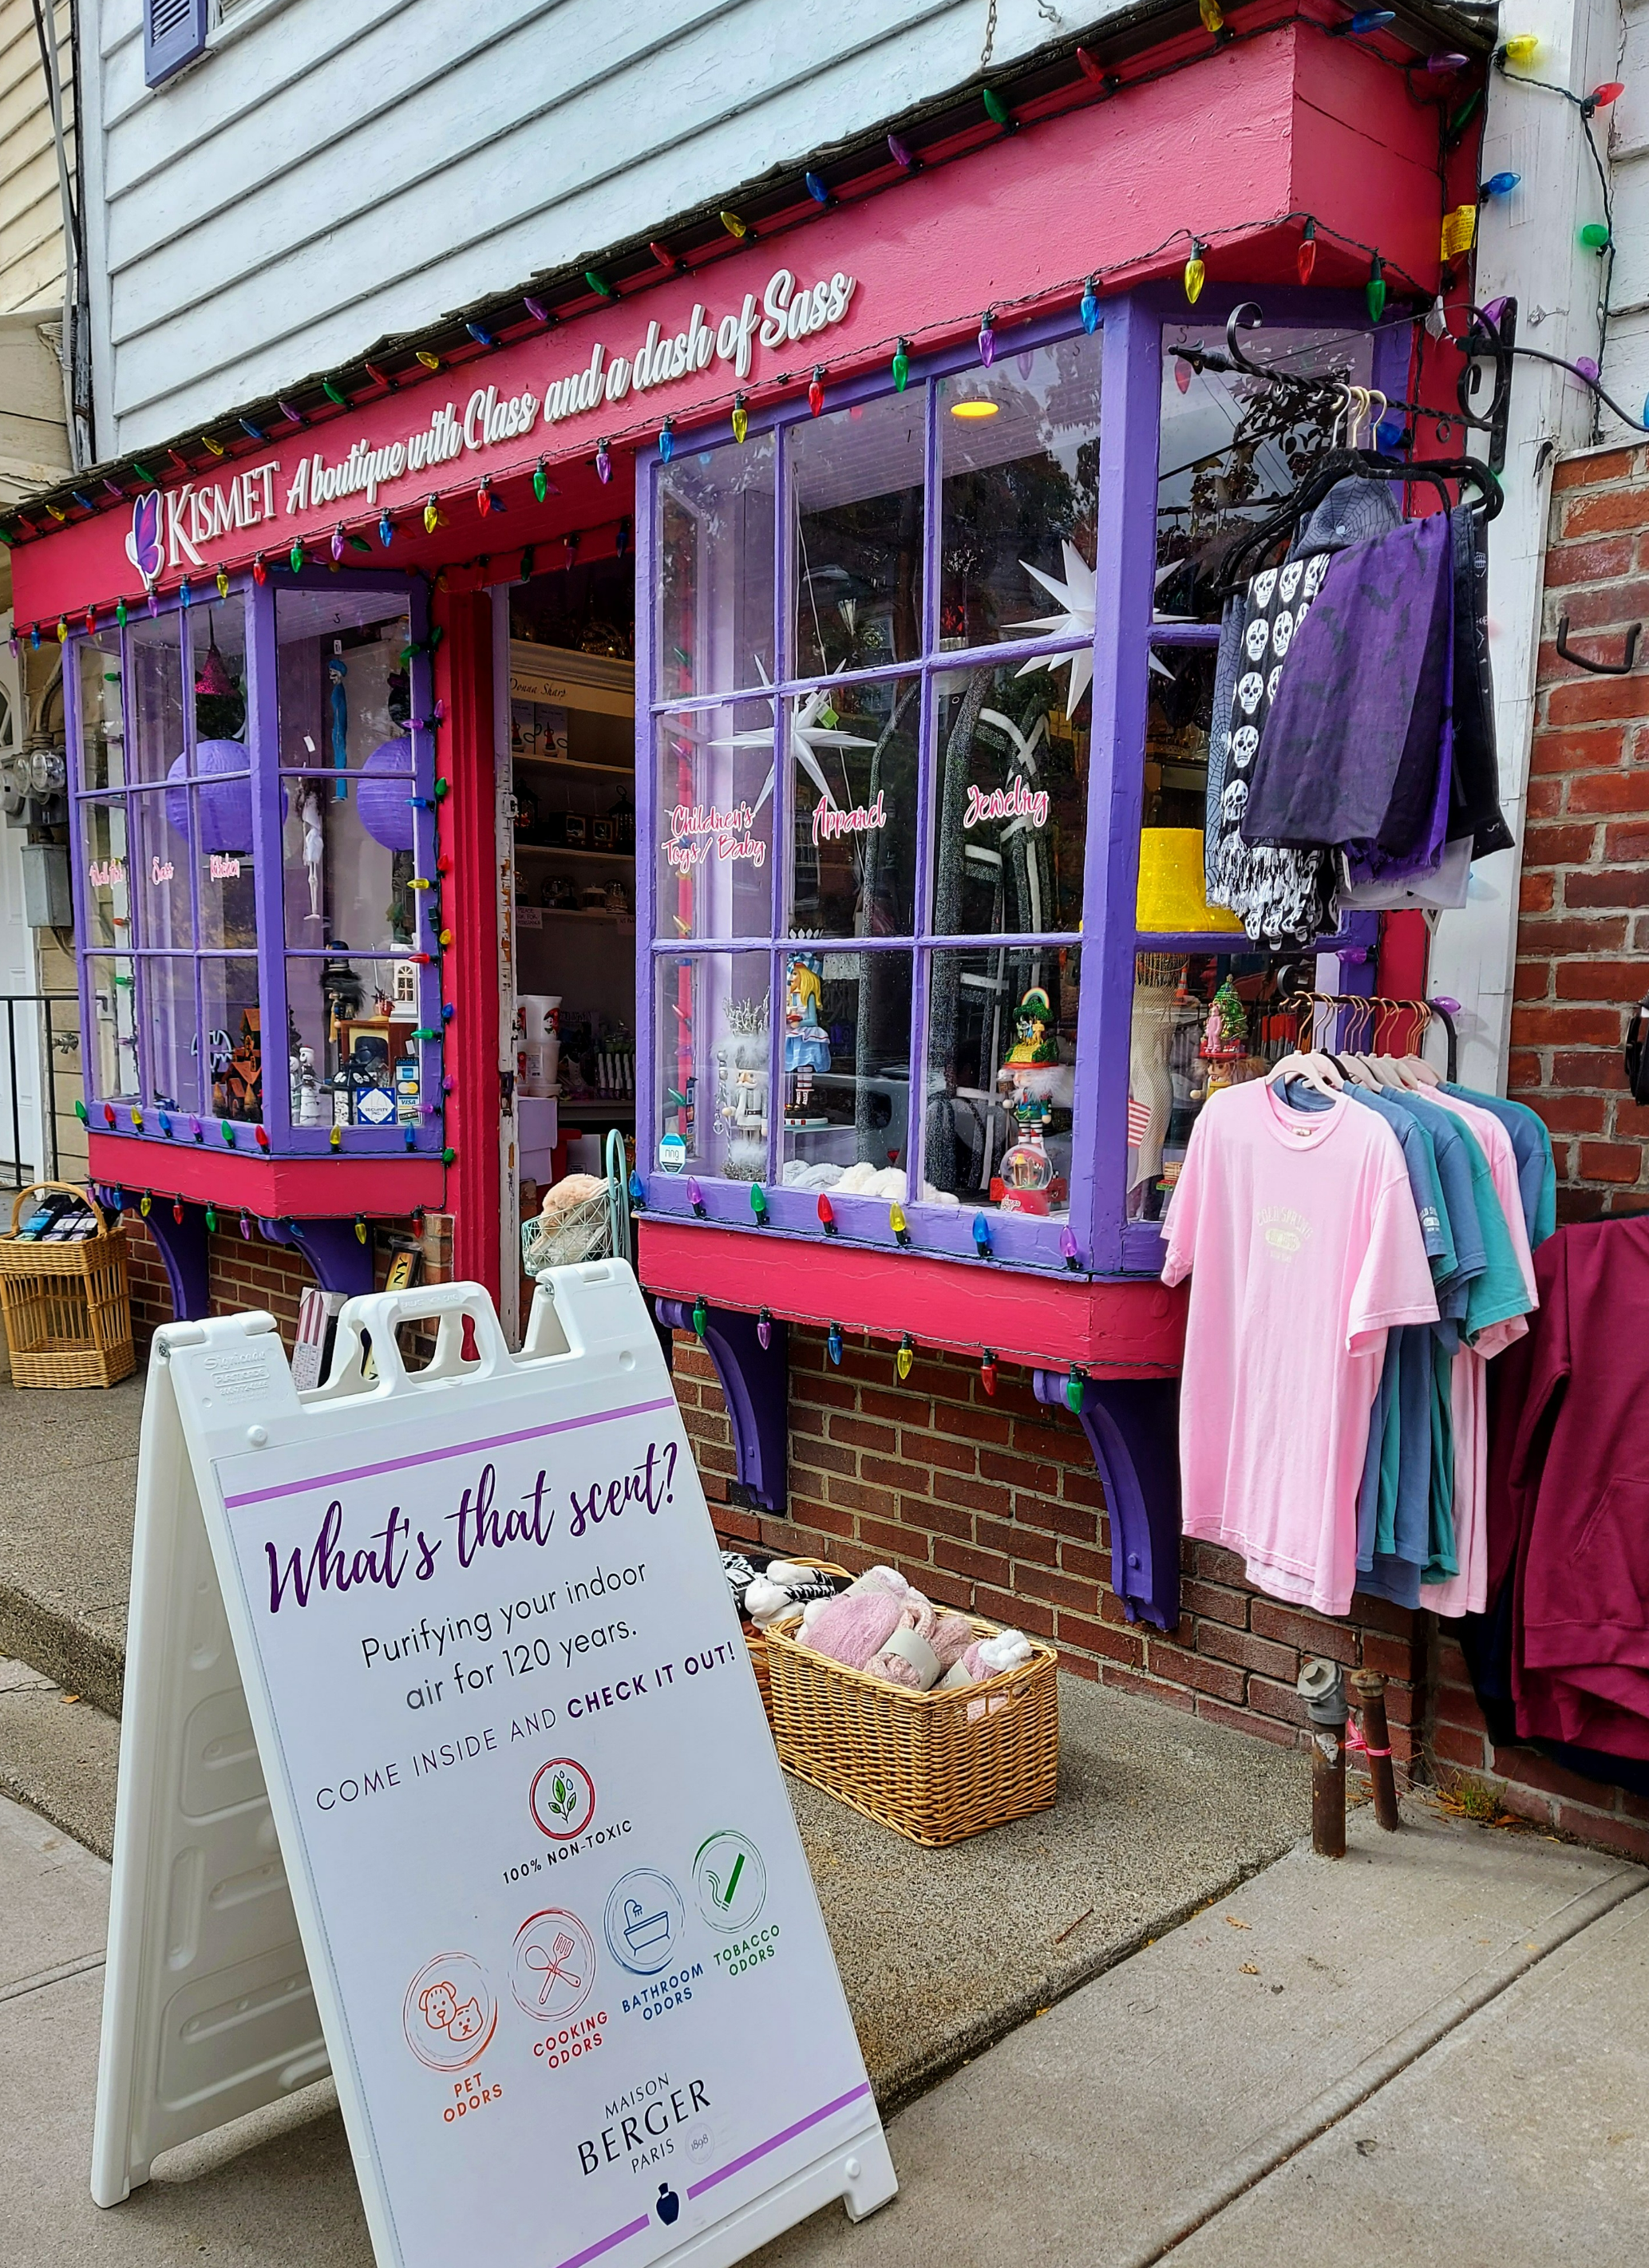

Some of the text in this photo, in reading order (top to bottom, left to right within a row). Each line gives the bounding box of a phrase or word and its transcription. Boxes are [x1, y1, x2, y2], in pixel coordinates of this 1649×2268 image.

[286, 268, 857, 515] A boutique with Class and a dash of Sass
[164, 460, 281, 568] KISMET
[671, 801, 756, 838] Children's
[812, 790, 888, 845] Apparel
[963, 774, 1050, 828] Jewelry
[718, 831, 766, 867] Baby
[665, 1147, 679, 1161] ring
[393, 1256, 408, 1285] NY
[265, 1442, 678, 1614] What's that scent?
[361, 1563, 647, 1669] Purifying your indoor
[405, 1620, 638, 1710] air for 120 years.
[316, 1642, 737, 1811] COME INSIDE AND CHECK IT OUT!
[502, 1820, 633, 1885] 100% NON-TOXIC
[713, 1924, 781, 1966] TOBACCO
[728, 1945, 776, 1977] ODORS
[621, 1962, 705, 2014] BATHROOM
[643, 1986, 693, 2021] ODORS
[532, 2011, 608, 2058] COOKING
[548, 2033, 603, 2070] ODORS
[443, 2084, 503, 2124] ODORS
[453, 2072, 483, 2098] PET
[604, 2072, 670, 2120] MAISON
[577, 2080, 711, 2176] BERGER
[690, 2133, 710, 2151] 1898
[631, 2138, 675, 2174] PARIS
